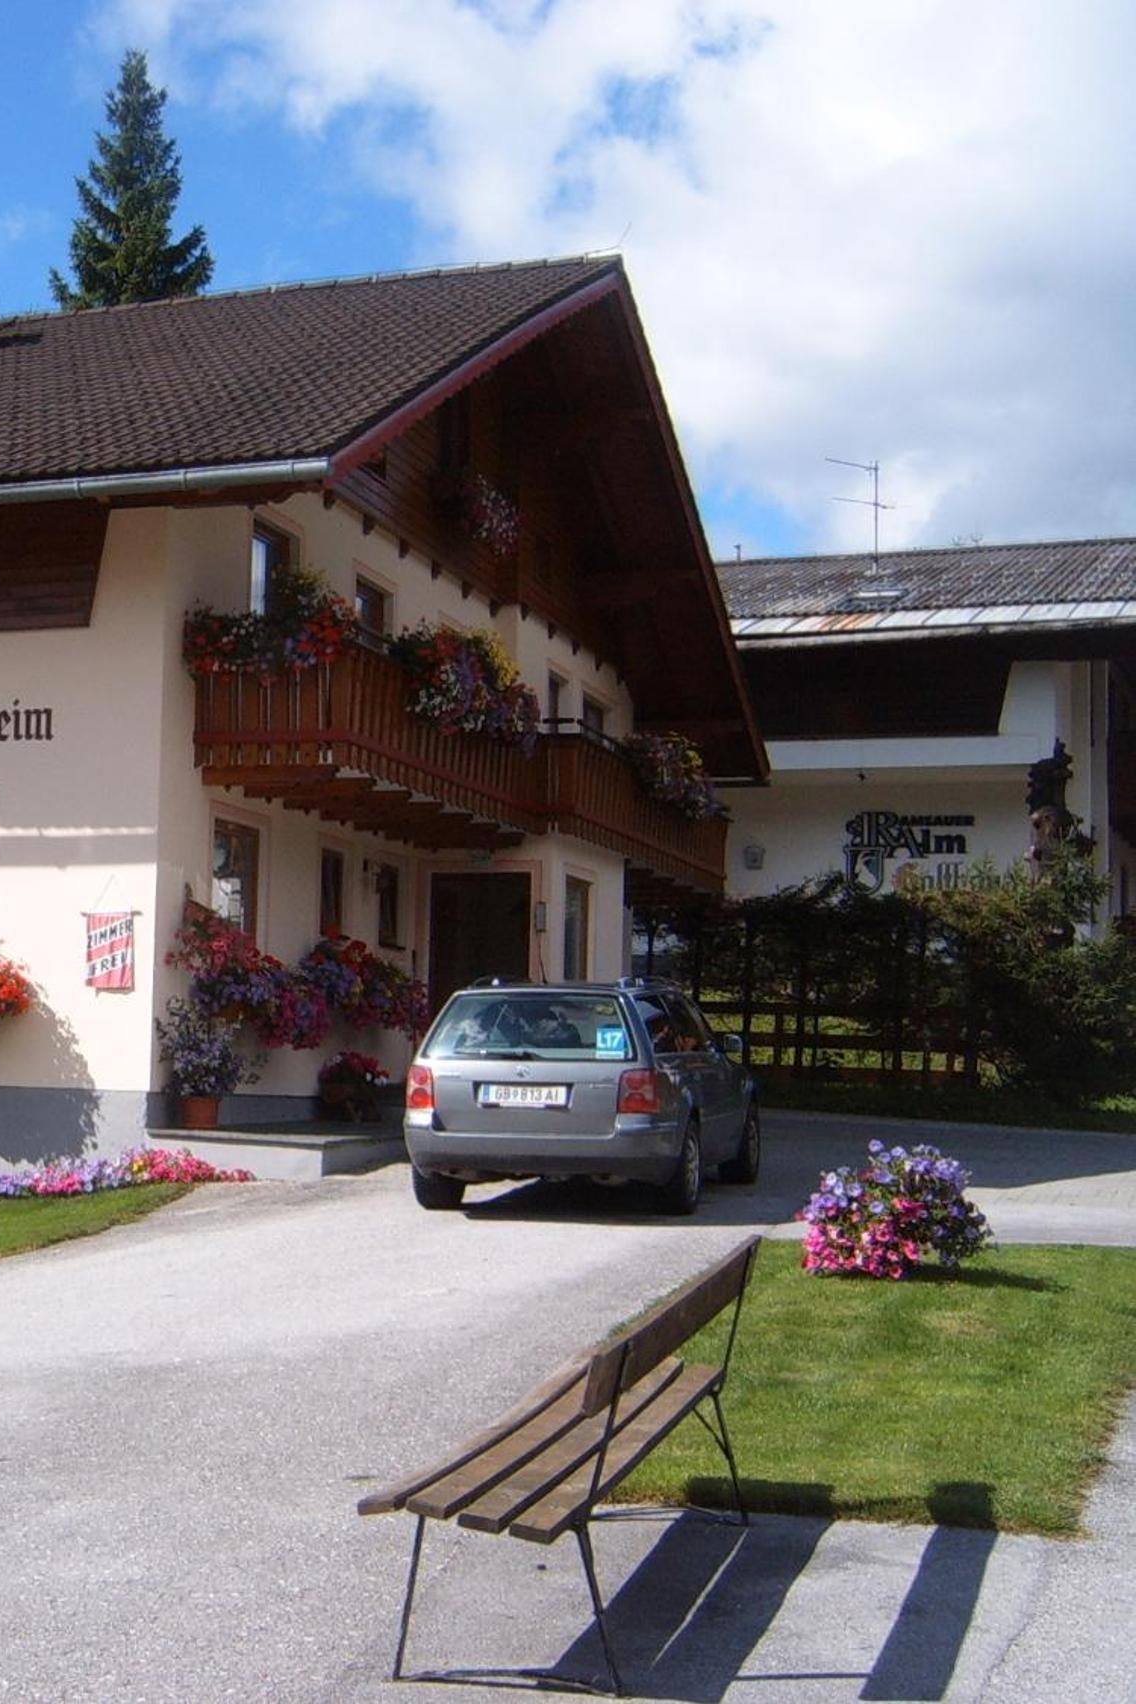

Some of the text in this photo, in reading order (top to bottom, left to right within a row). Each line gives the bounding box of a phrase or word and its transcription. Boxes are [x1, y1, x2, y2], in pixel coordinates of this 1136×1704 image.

[885, 824, 968, 859] Alm
[87, 918, 133, 950] ZIMMER
[597, 1025, 623, 1048] L17
